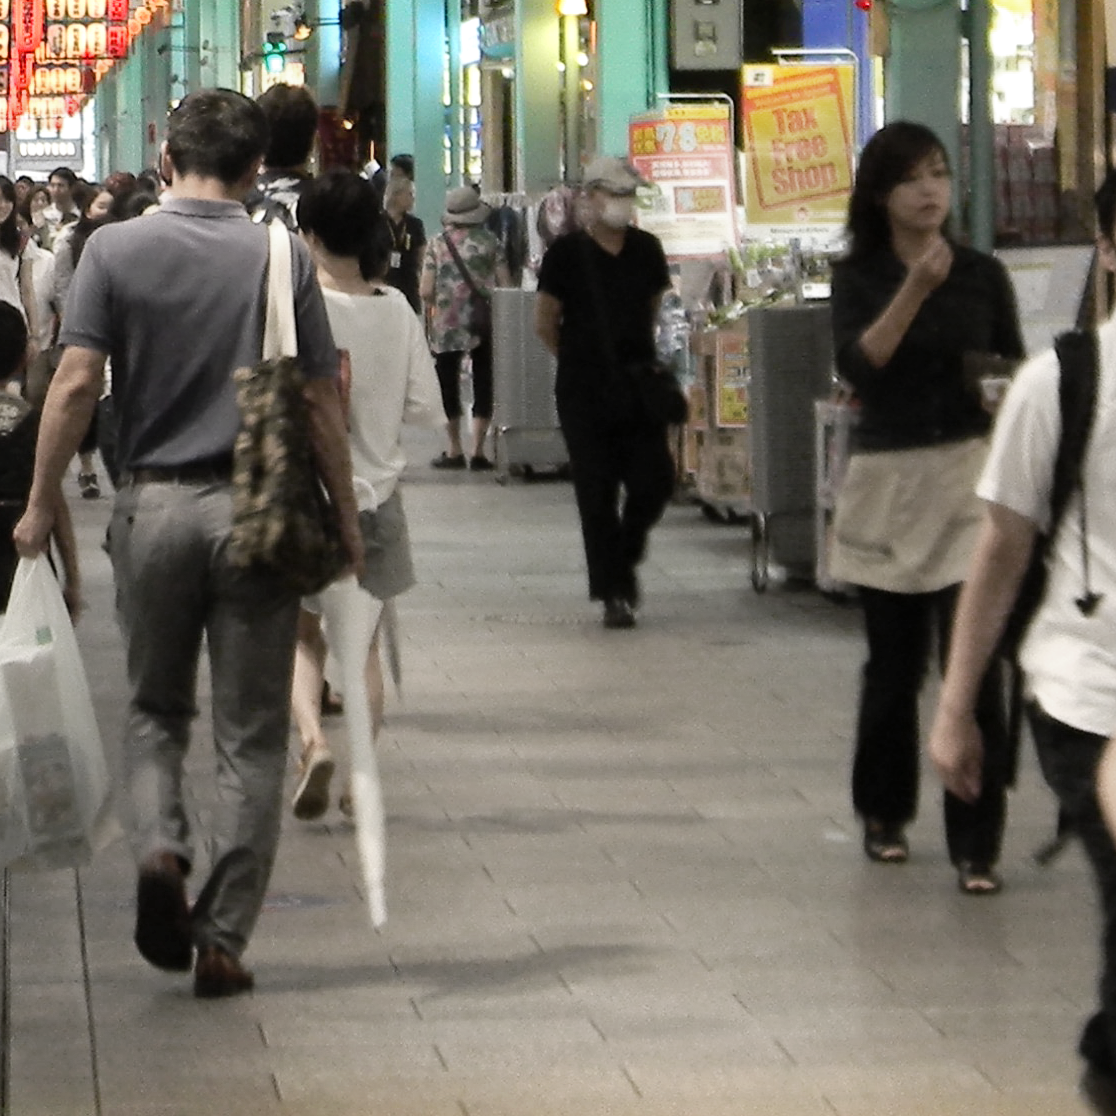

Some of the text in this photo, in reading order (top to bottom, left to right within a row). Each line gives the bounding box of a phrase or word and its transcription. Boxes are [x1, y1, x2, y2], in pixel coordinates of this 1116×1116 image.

[771, 108, 819, 135] Tax
[771, 135, 829, 166] Free
[771, 162, 838, 195] Shop
